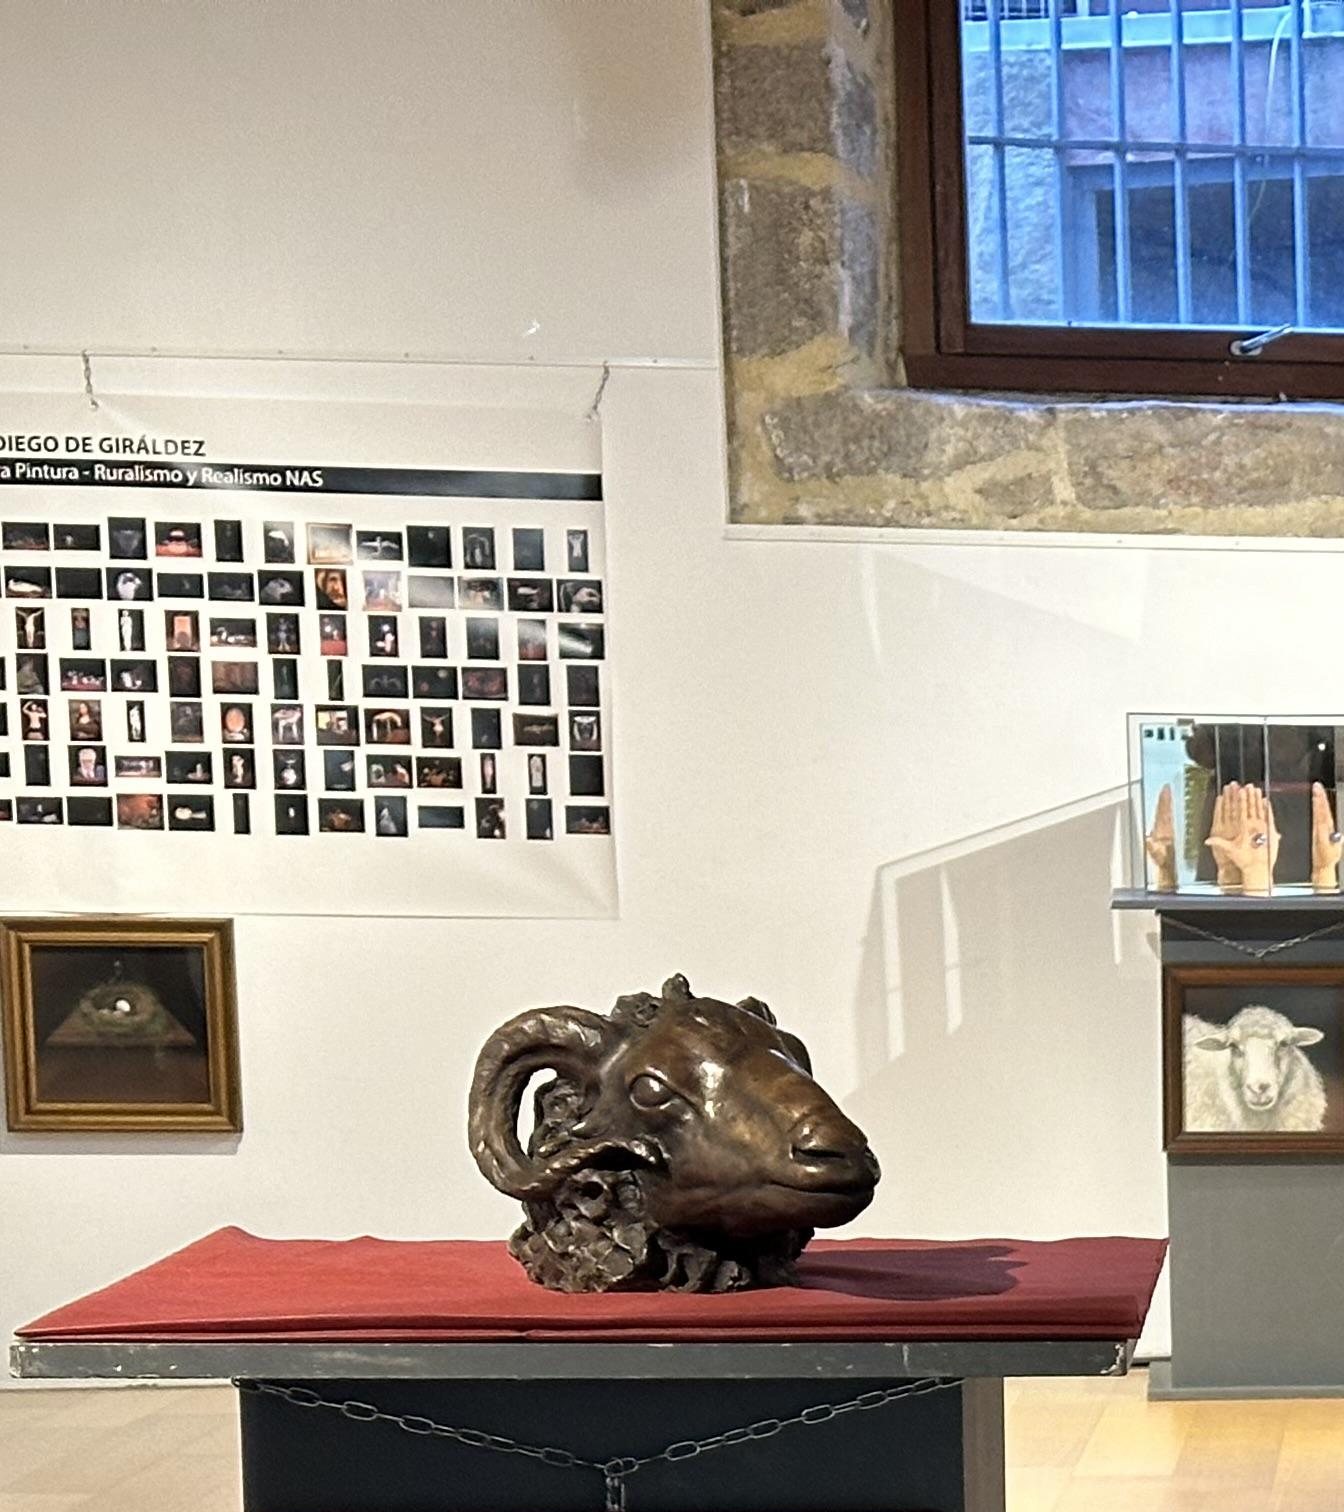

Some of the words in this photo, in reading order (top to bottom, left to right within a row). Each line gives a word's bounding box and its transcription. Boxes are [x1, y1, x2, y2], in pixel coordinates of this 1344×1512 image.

[65, 436, 94, 453] DE
[98, 434, 207, 457] GIRÁLDEZ
[14, 462, 80, 481] Pintura
[94, 463, 183, 483] Ruralismo
[186, 470, 198, 486] y
[201, 467, 282, 486] Realismo
[285, 469, 324, 487] NAS
